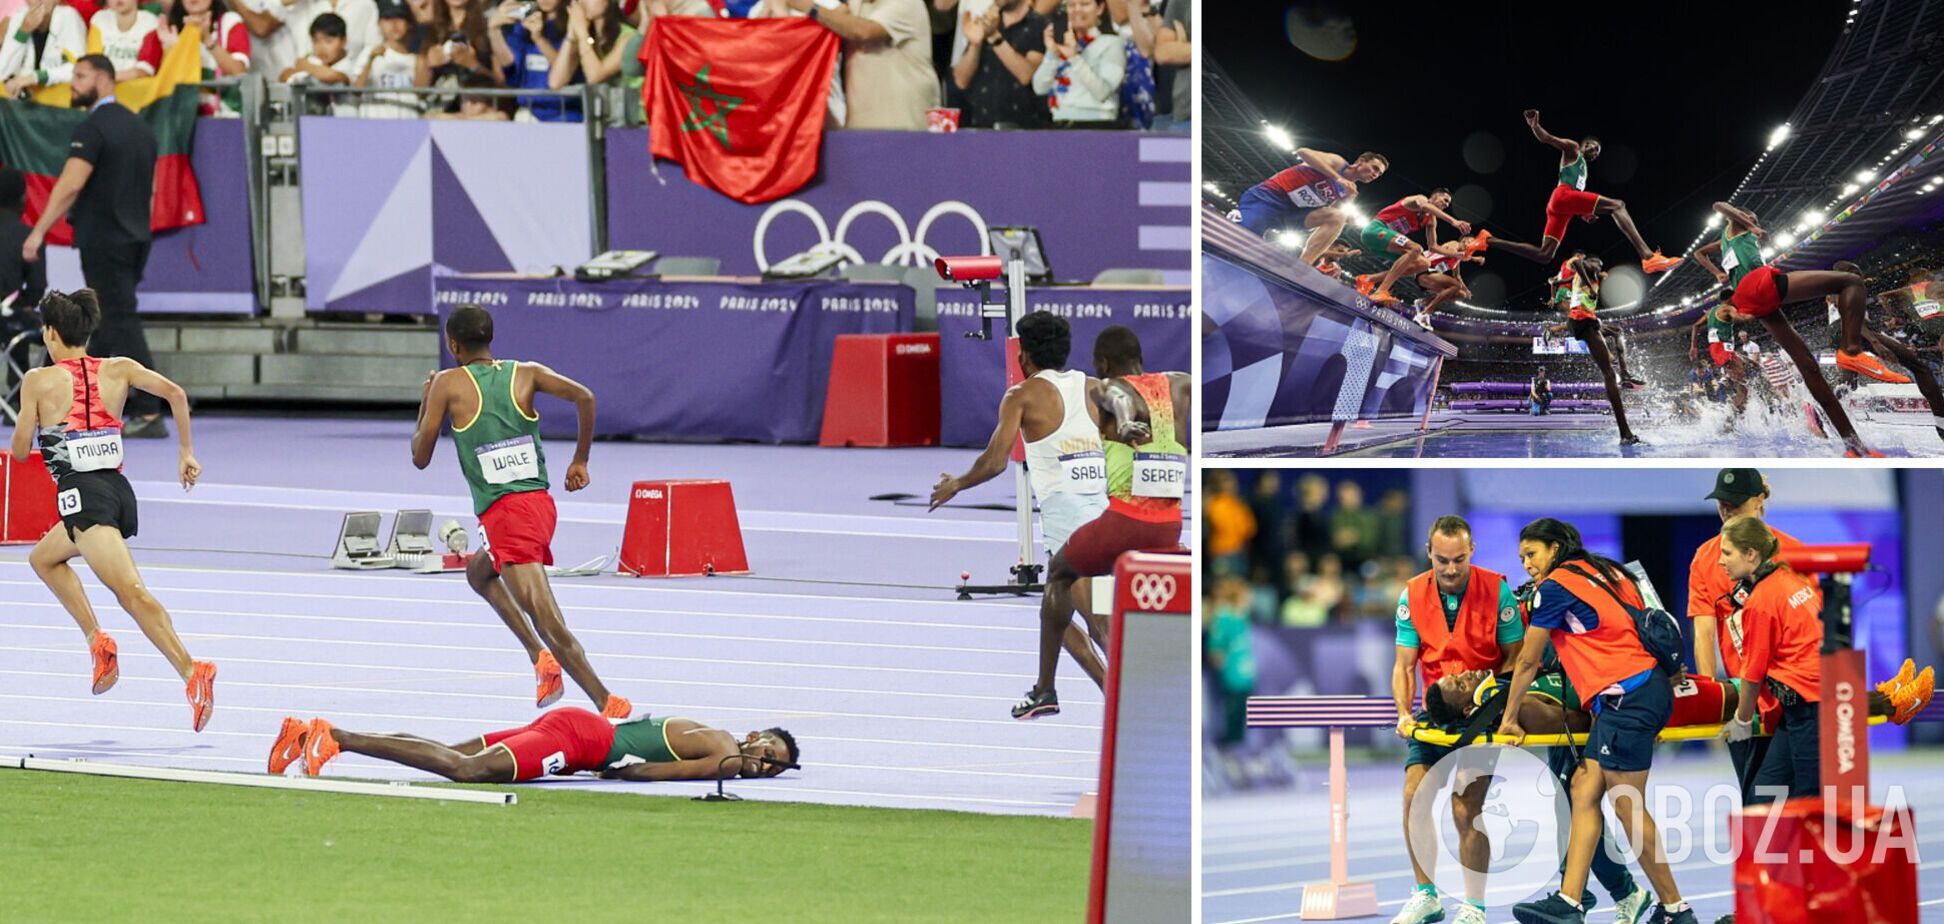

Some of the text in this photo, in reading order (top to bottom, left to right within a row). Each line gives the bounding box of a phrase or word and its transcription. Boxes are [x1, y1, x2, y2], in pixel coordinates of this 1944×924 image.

[528, 292, 566, 307] PARIS
[622, 294, 700, 309] PARIS 2024
[720, 296, 798, 312] PARIS 2024
[821, 297, 899, 312] PARIS 2024
[936, 302, 975, 316] PARIS
[1076, 304, 1112, 318] 2024
[1133, 304, 1175, 319] PARIS
[76, 442, 119, 459] MIURA
[493, 452, 530, 471] WALE
[1071, 465, 1107, 481] SABL
[642, 489, 664, 499] OMEGA
[60, 494, 77, 511] 13
[1836, 702, 1856, 775] OMEGA
